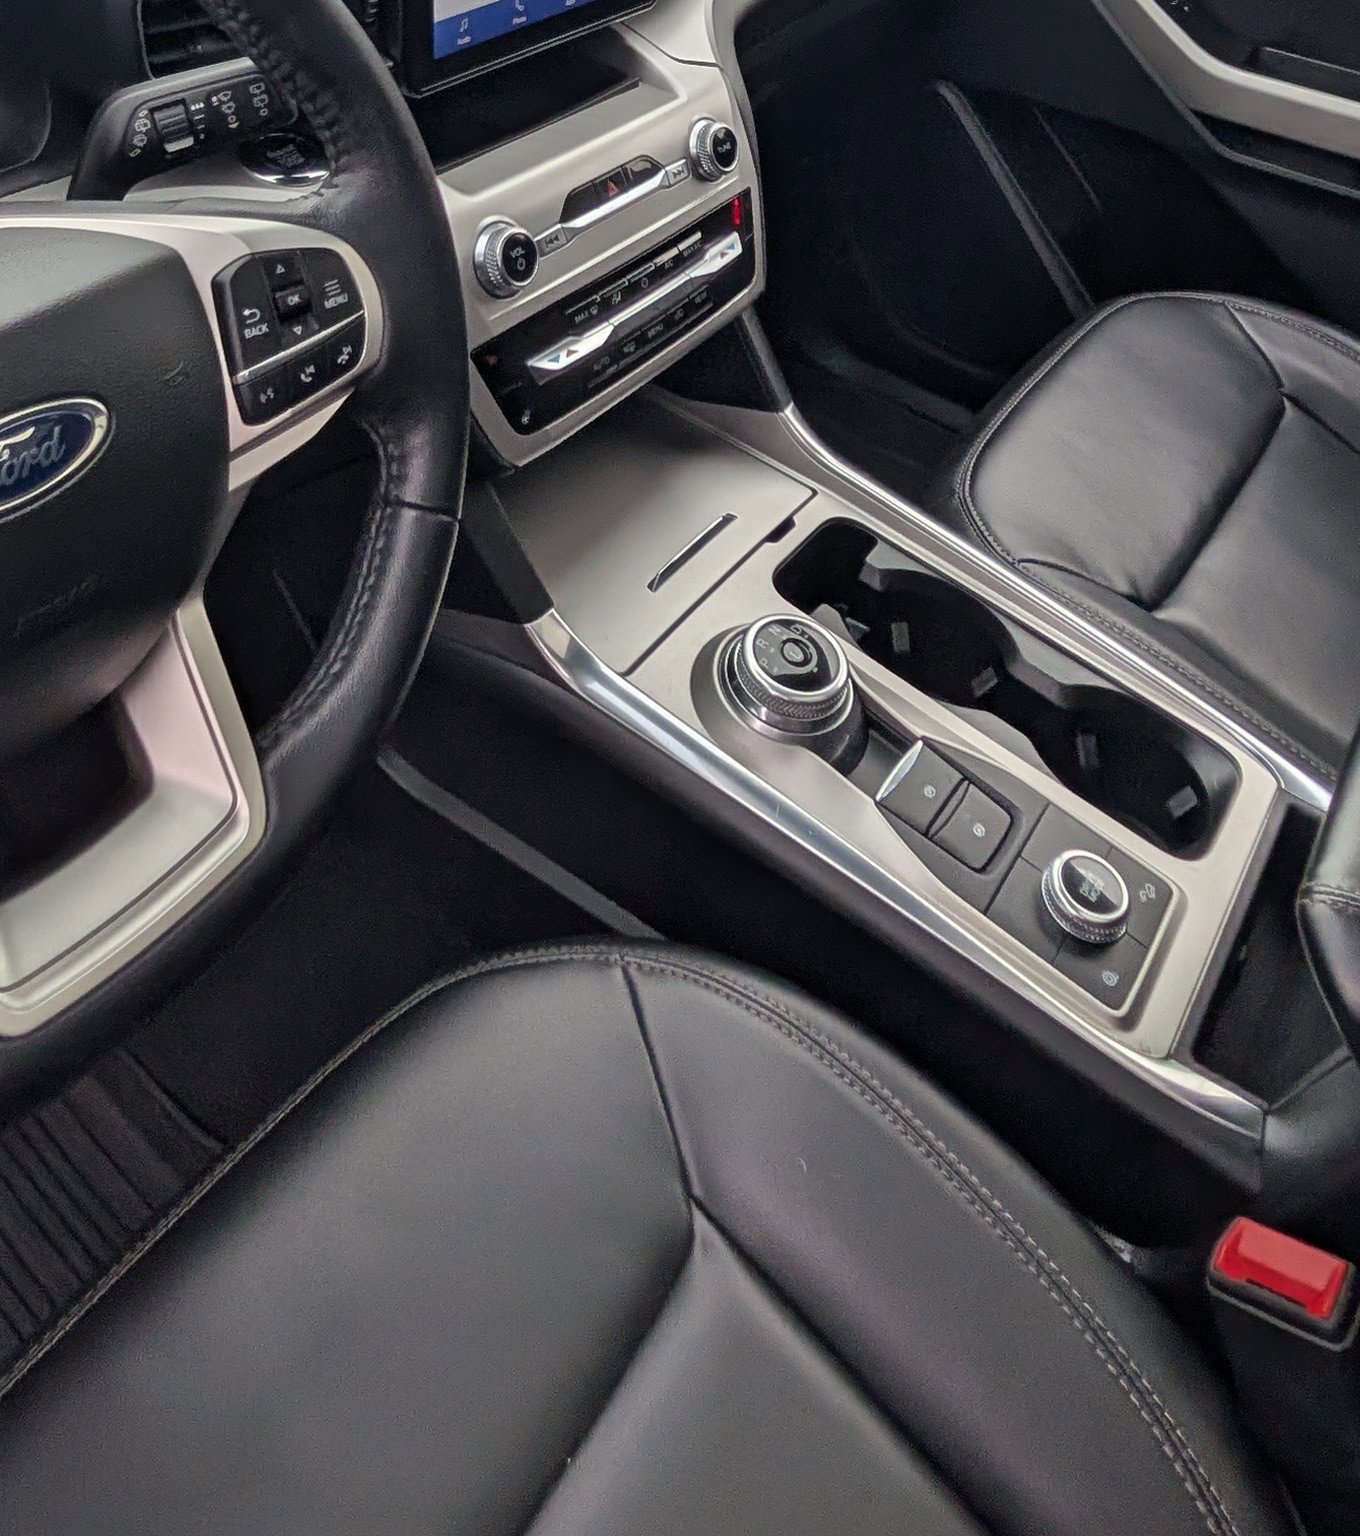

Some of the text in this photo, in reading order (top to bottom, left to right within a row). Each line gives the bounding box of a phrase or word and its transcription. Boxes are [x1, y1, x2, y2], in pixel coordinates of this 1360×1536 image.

[287, 294, 301, 305] OK
[324, 293, 349, 310] MENU
[243, 323, 270, 339] BACK
